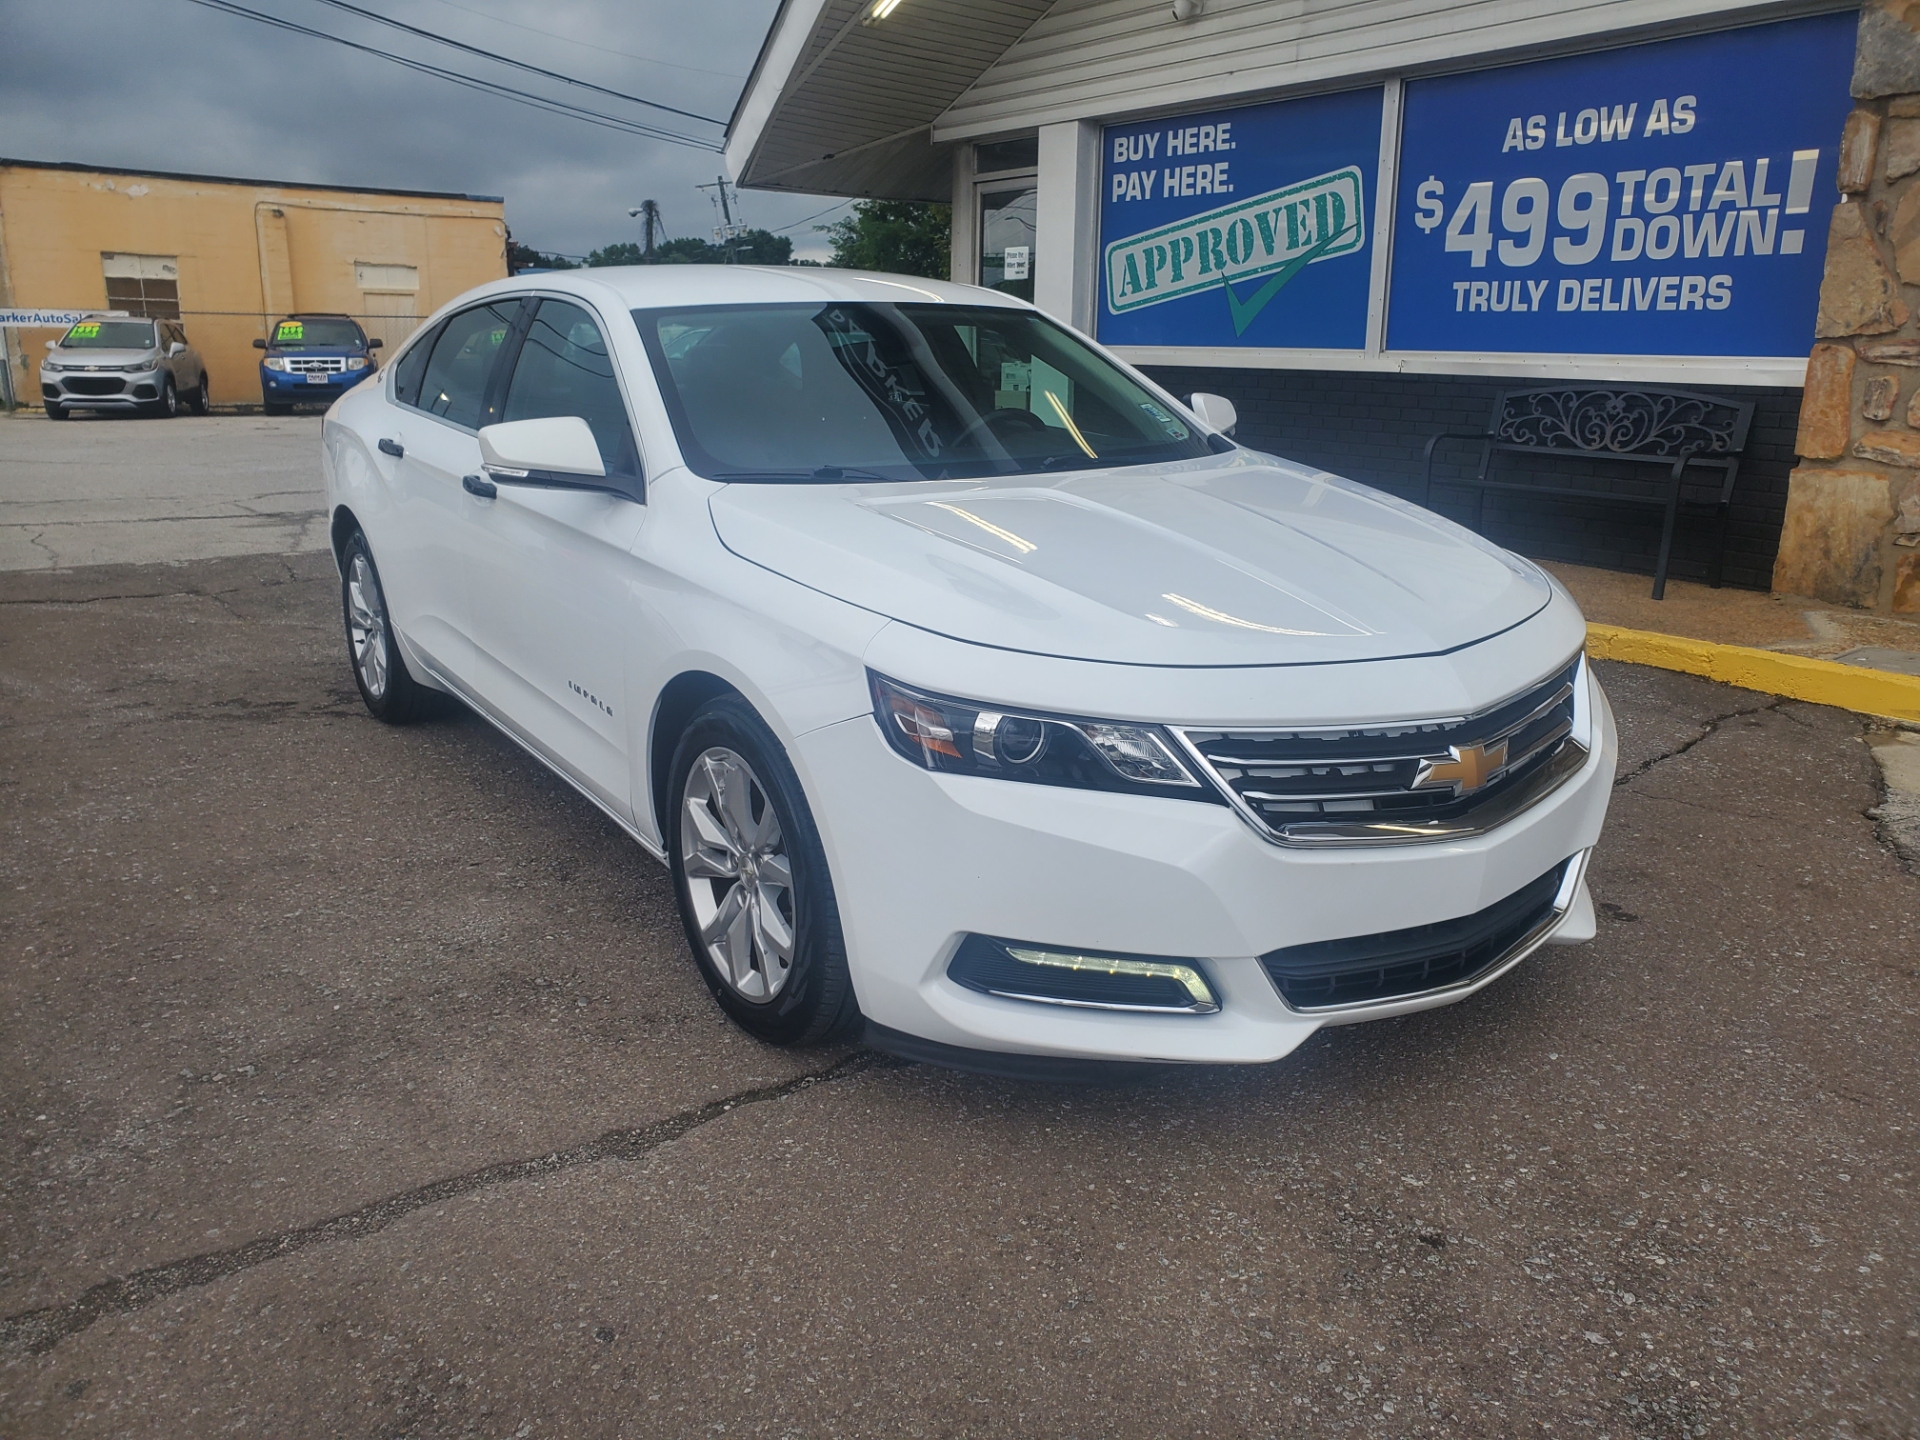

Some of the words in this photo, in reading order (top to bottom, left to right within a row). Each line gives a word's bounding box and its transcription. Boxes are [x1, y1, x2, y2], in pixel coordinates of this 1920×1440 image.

[1112, 132, 1161, 164] BUY
[1166, 122, 1237, 157] HERE.
[1502, 114, 1547, 153] AS
[1555, 102, 1638, 148] LOW
[1643, 95, 1697, 137] AS
[1111, 170, 1157, 203] PAY
[1162, 161, 1235, 198] HERE.
[1615, 157, 1782, 216] TOTAL
[1118, 190, 1347, 299] APPROVED
[1414, 172, 1610, 268] $499
[1452, 279, 1550, 313] TRULY
[1556, 274, 1733, 312] DELIVERS
[568, 680, 613, 717] IMPALA
